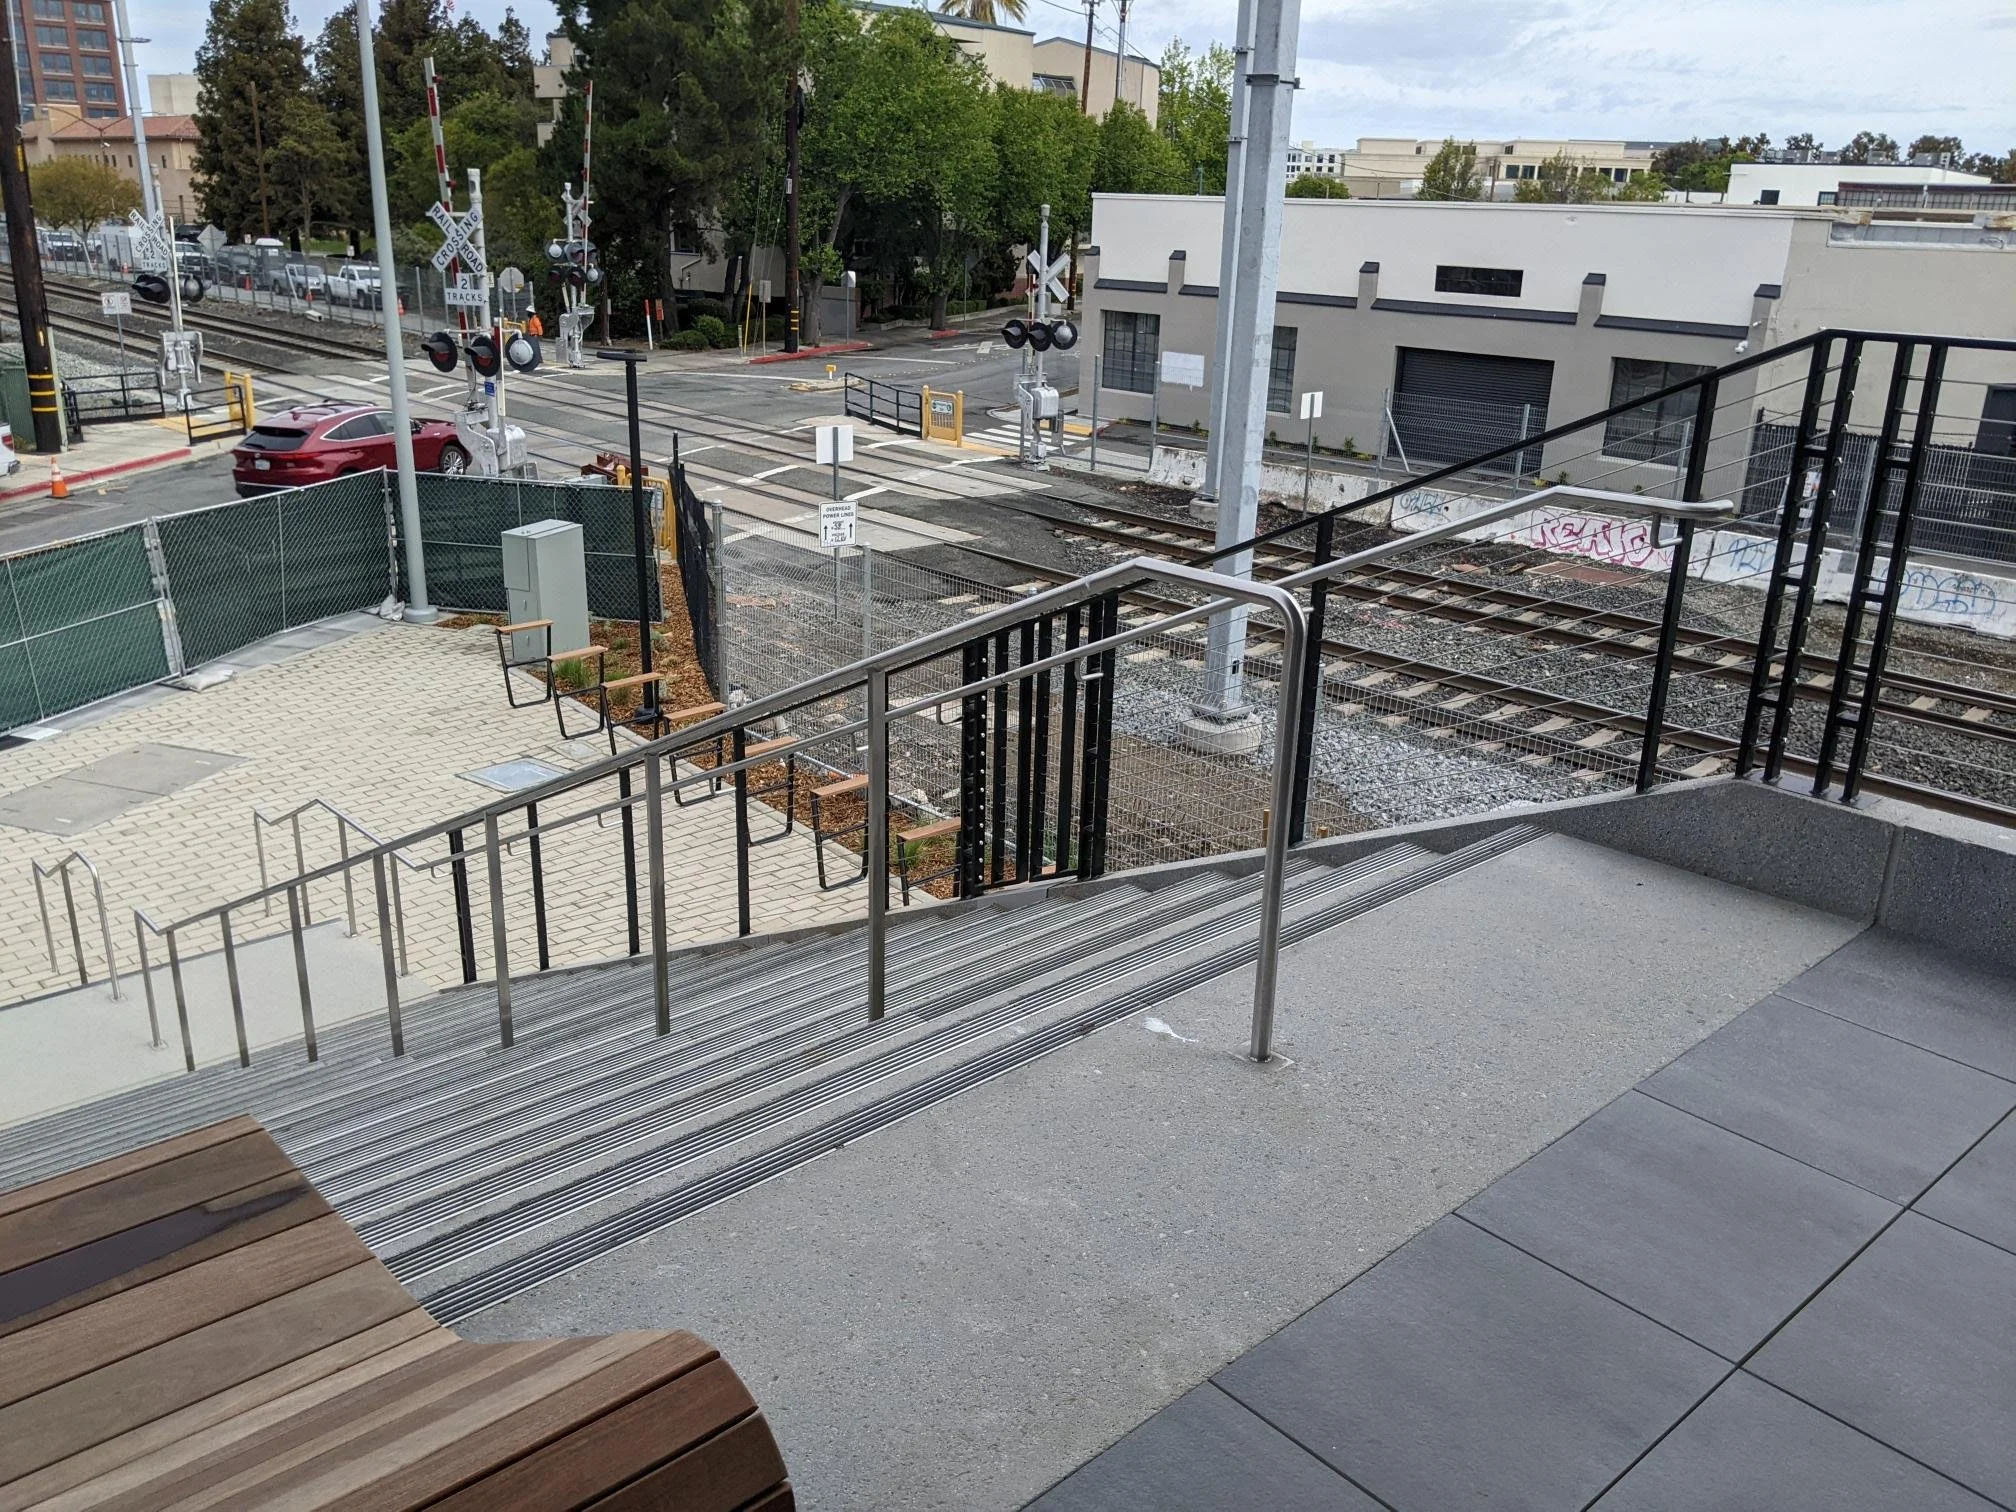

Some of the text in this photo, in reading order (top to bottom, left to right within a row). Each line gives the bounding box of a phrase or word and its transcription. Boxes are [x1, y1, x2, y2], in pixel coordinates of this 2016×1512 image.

[131, 212, 168, 256] RAIL ROAD
[136, 214, 161, 253] CROSSING
[432, 206, 483, 272] RAIL ROAD
[436, 211, 477, 266] CROSSING
[447, 293, 483, 302] TRACKS
[461, 279, 468, 290] 2
